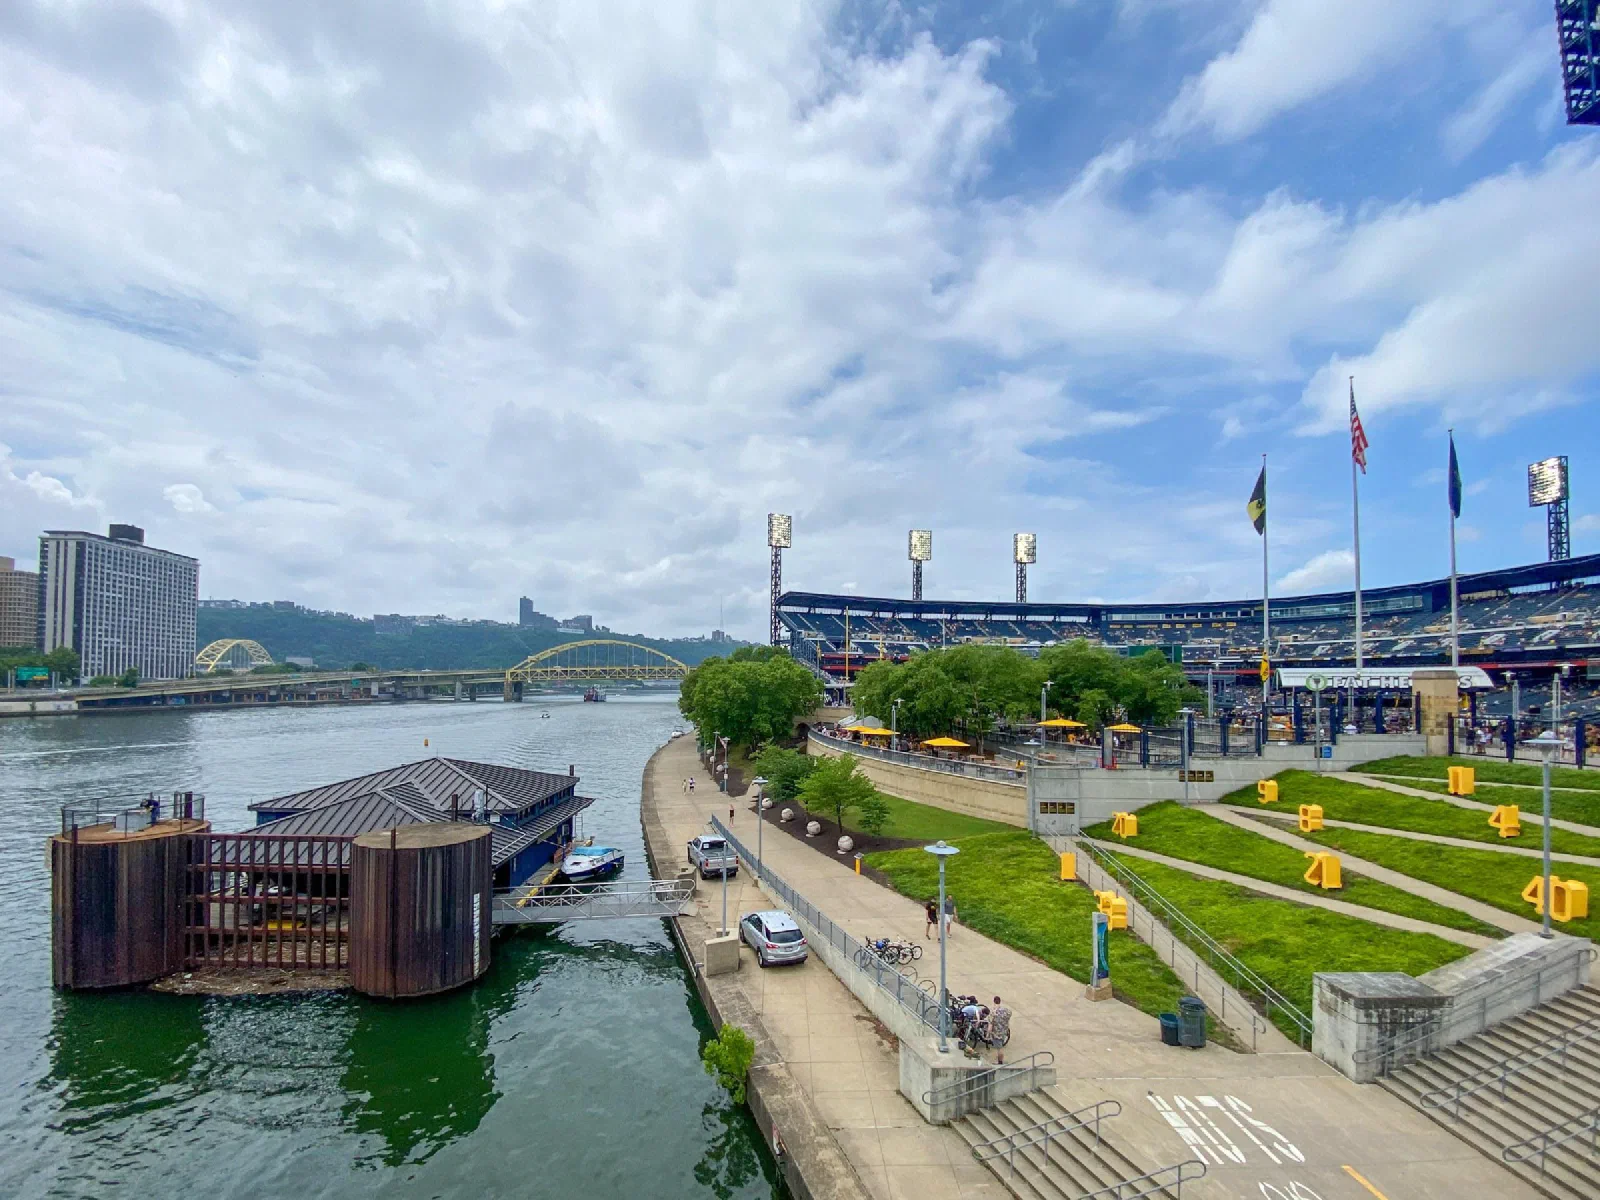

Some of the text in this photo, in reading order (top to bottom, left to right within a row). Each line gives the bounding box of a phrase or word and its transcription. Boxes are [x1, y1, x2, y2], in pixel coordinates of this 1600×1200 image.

[1332, 675, 1472, 689] FAT HES
[1298, 804, 1324, 832] 8
[1488, 804, 1520, 838] 4
[1521, 875, 1589, 922] 40
